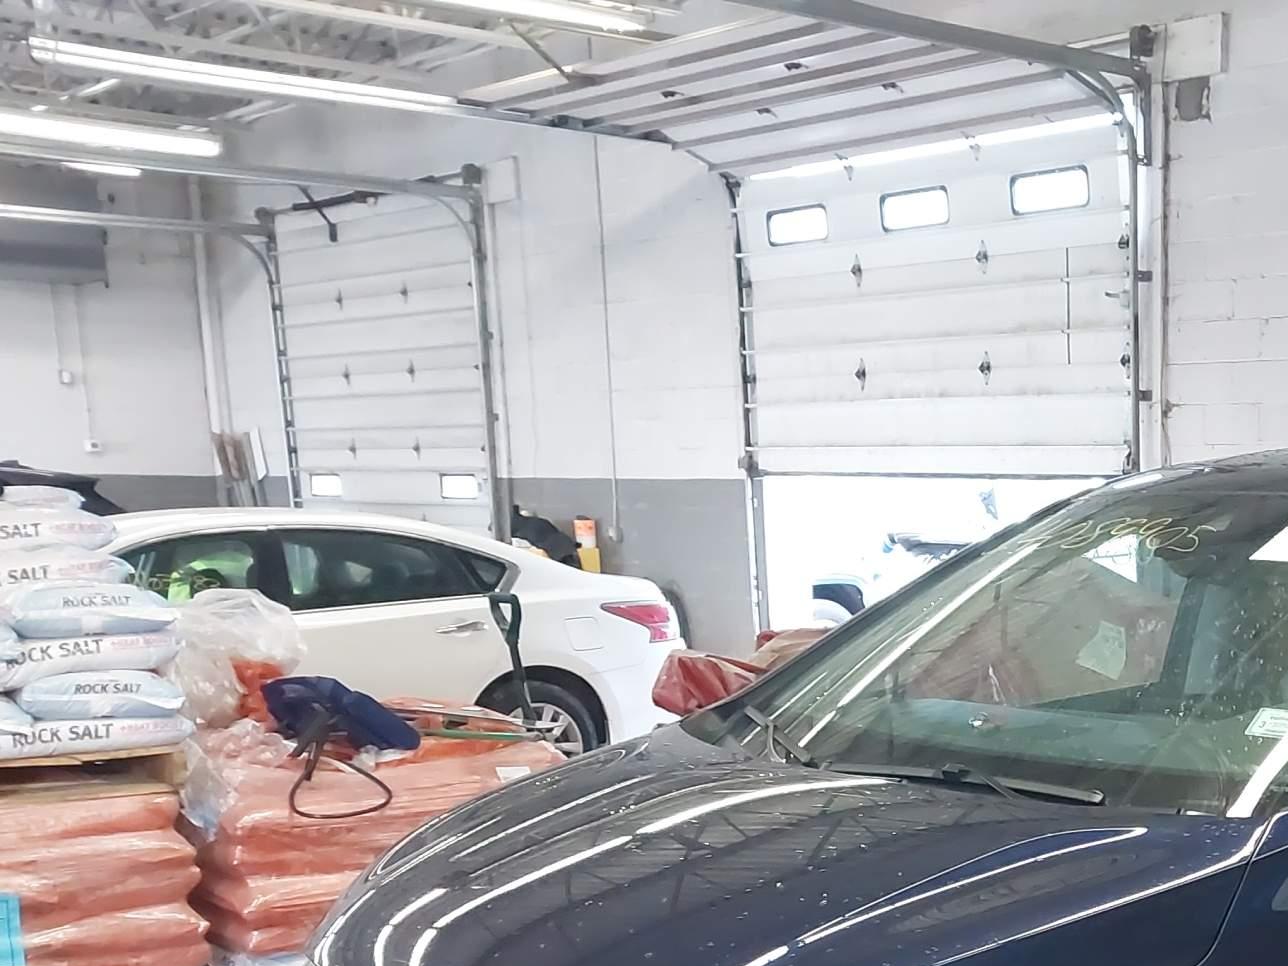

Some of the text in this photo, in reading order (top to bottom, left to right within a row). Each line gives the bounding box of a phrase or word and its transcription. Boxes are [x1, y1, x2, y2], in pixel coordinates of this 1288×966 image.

[0, 522, 41, 539] SALT
[7, 564, 50, 584] SALT
[62, 595, 131, 608] ROCK SALT
[58, 638, 104, 658] SALT
[74, 682, 142, 695] ROCK SALT
[68, 723, 114, 741] SALT
